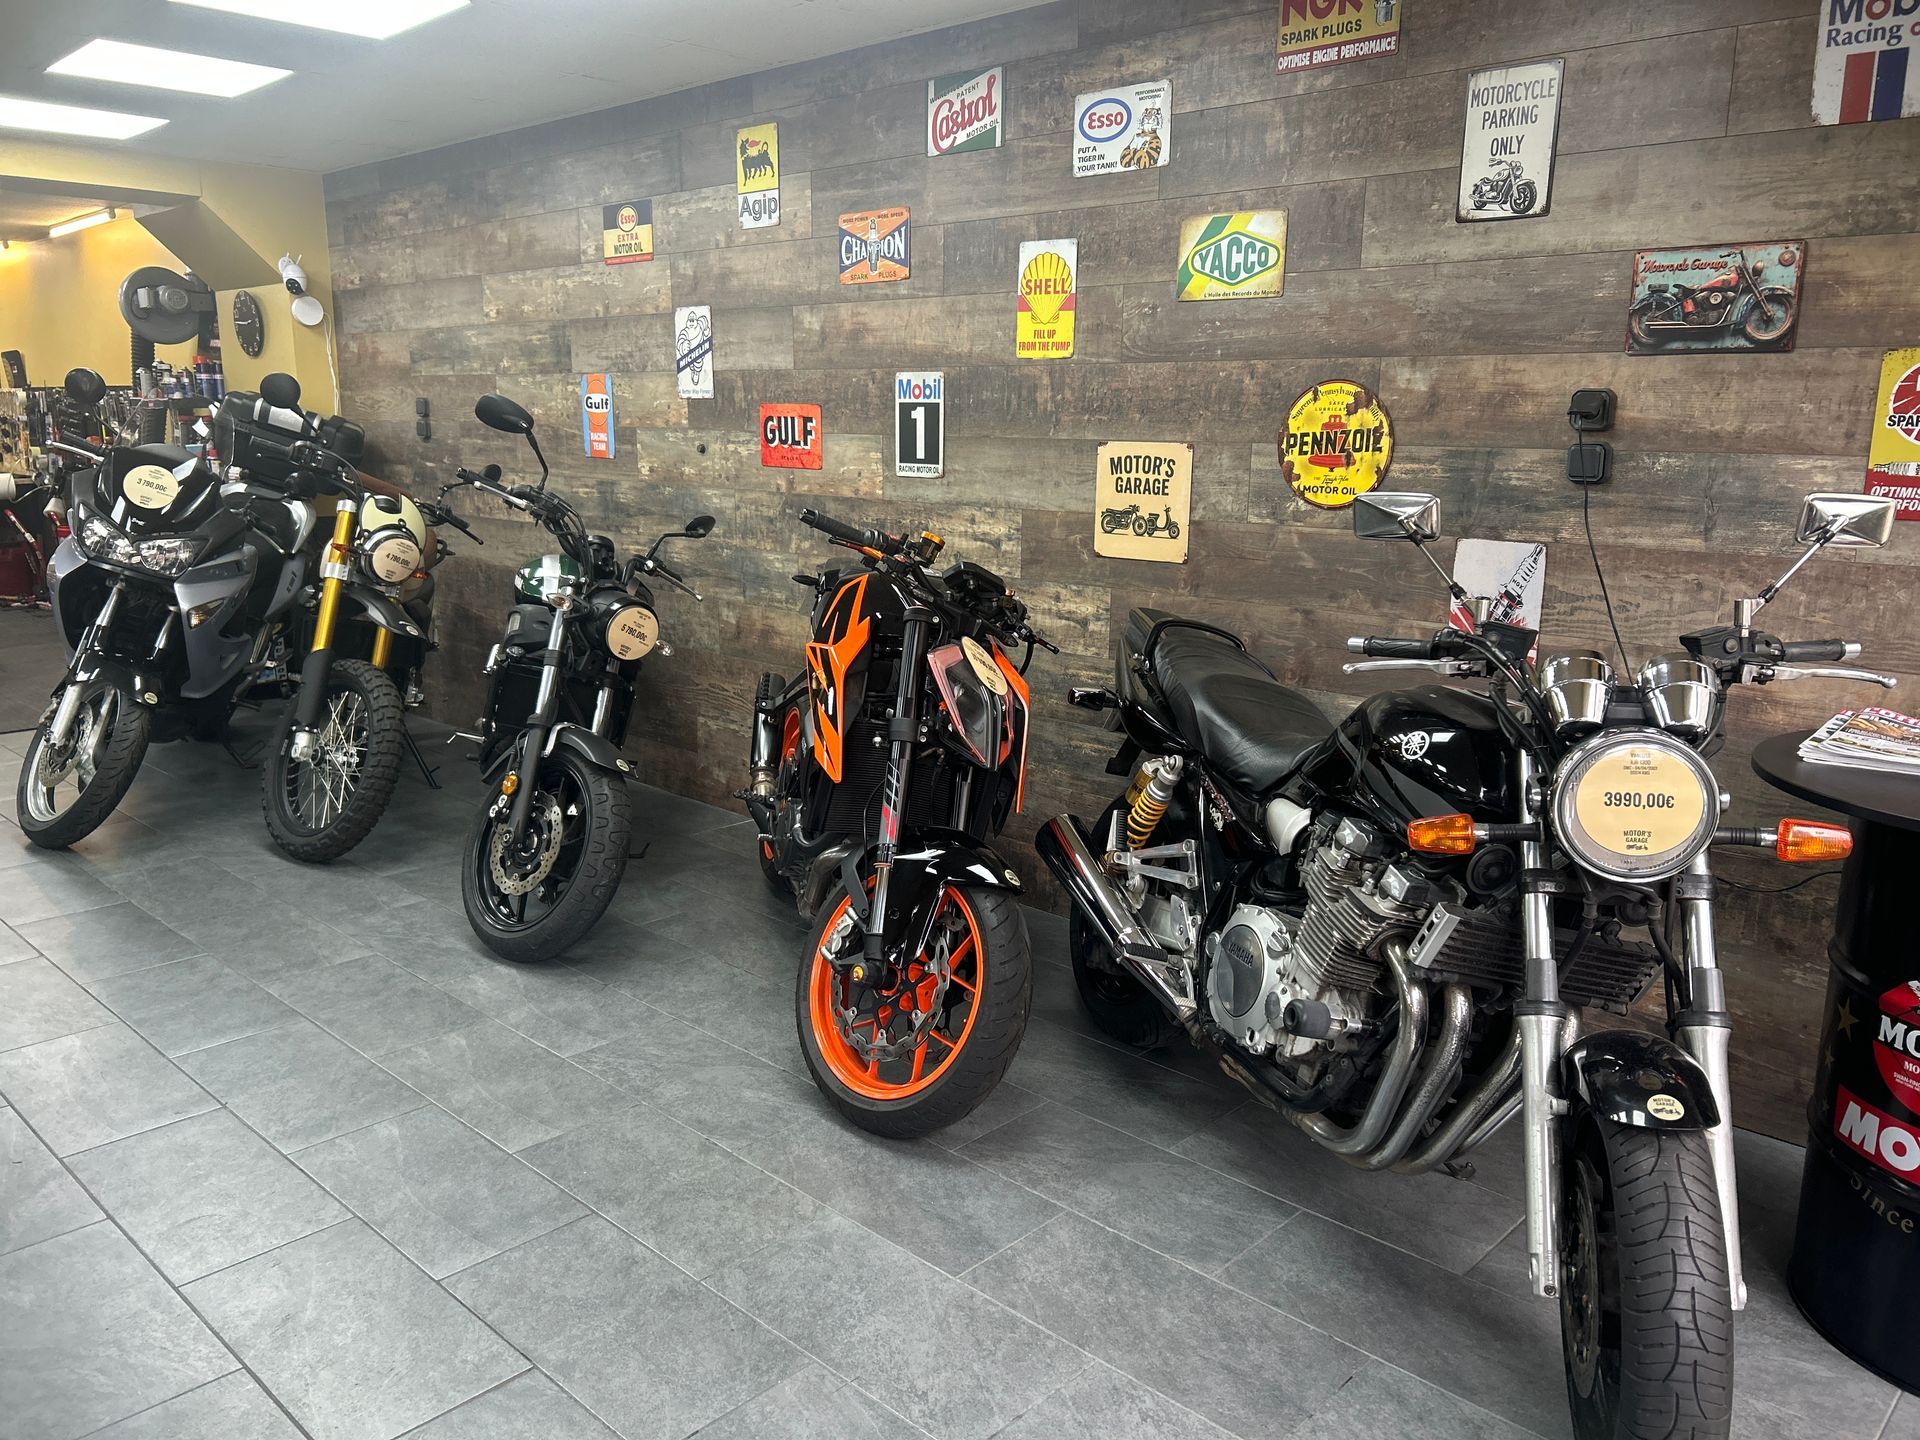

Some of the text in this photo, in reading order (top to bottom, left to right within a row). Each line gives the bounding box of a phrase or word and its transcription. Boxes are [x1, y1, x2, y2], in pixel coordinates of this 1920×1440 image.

[1281, 18, 1362, 46] SPARK PLUGS
[1826, 22, 1905, 48] Racing
[1277, 36, 1397, 71] OPTIMISE ENGINE PERFORMANCE
[956, 81, 980, 100] PATENT
[1470, 77, 1557, 109] MOTORCYCLE
[931, 73, 997, 154] Castrol
[1481, 104, 1540, 131] PARKING
[966, 118, 1000, 140] MOTOR OIL
[1077, 145, 1098, 155] PUT A
[1490, 134, 1526, 157] ONLY
[1076, 161, 1118, 173] YOUR TANK!
[1077, 153, 1106, 164] TIGER IN
[739, 193, 778, 222] Agip
[613, 241, 644, 255] MOTOR OIL
[617, 232, 640, 243] EXTRA
[841, 226, 905, 265] CHAMPION
[1198, 236, 1270, 281] YACCO
[1690, 257, 1729, 272] Garage
[850, 270, 897, 281] SPARK PLUGS
[1025, 277, 1069, 296] SHELL
[1033, 329, 1057, 340] FILL UP
[680, 341, 710, 369] MICHELIN
[1018, 341, 1071, 352] FROM THE PUMP
[898, 379, 941, 400] Mobil
[585, 396, 609, 410] Gulf
[763, 415, 817, 450] GULF
[910, 406, 926, 459] 1
[898, 465, 940, 474] RACING MOTOR OIL
[1109, 455, 1176, 478] MOTOR'S
[1115, 477, 1170, 496] GARAGE
[1302, 485, 1357, 495] MOTOR OIL
[1604, 791, 1675, 810] 3990,00€
[1623, 830, 1652, 838] MOTOR'S
[1228, 942, 1254, 967] YAMAHA
[1850, 1174, 1915, 1233] Since
